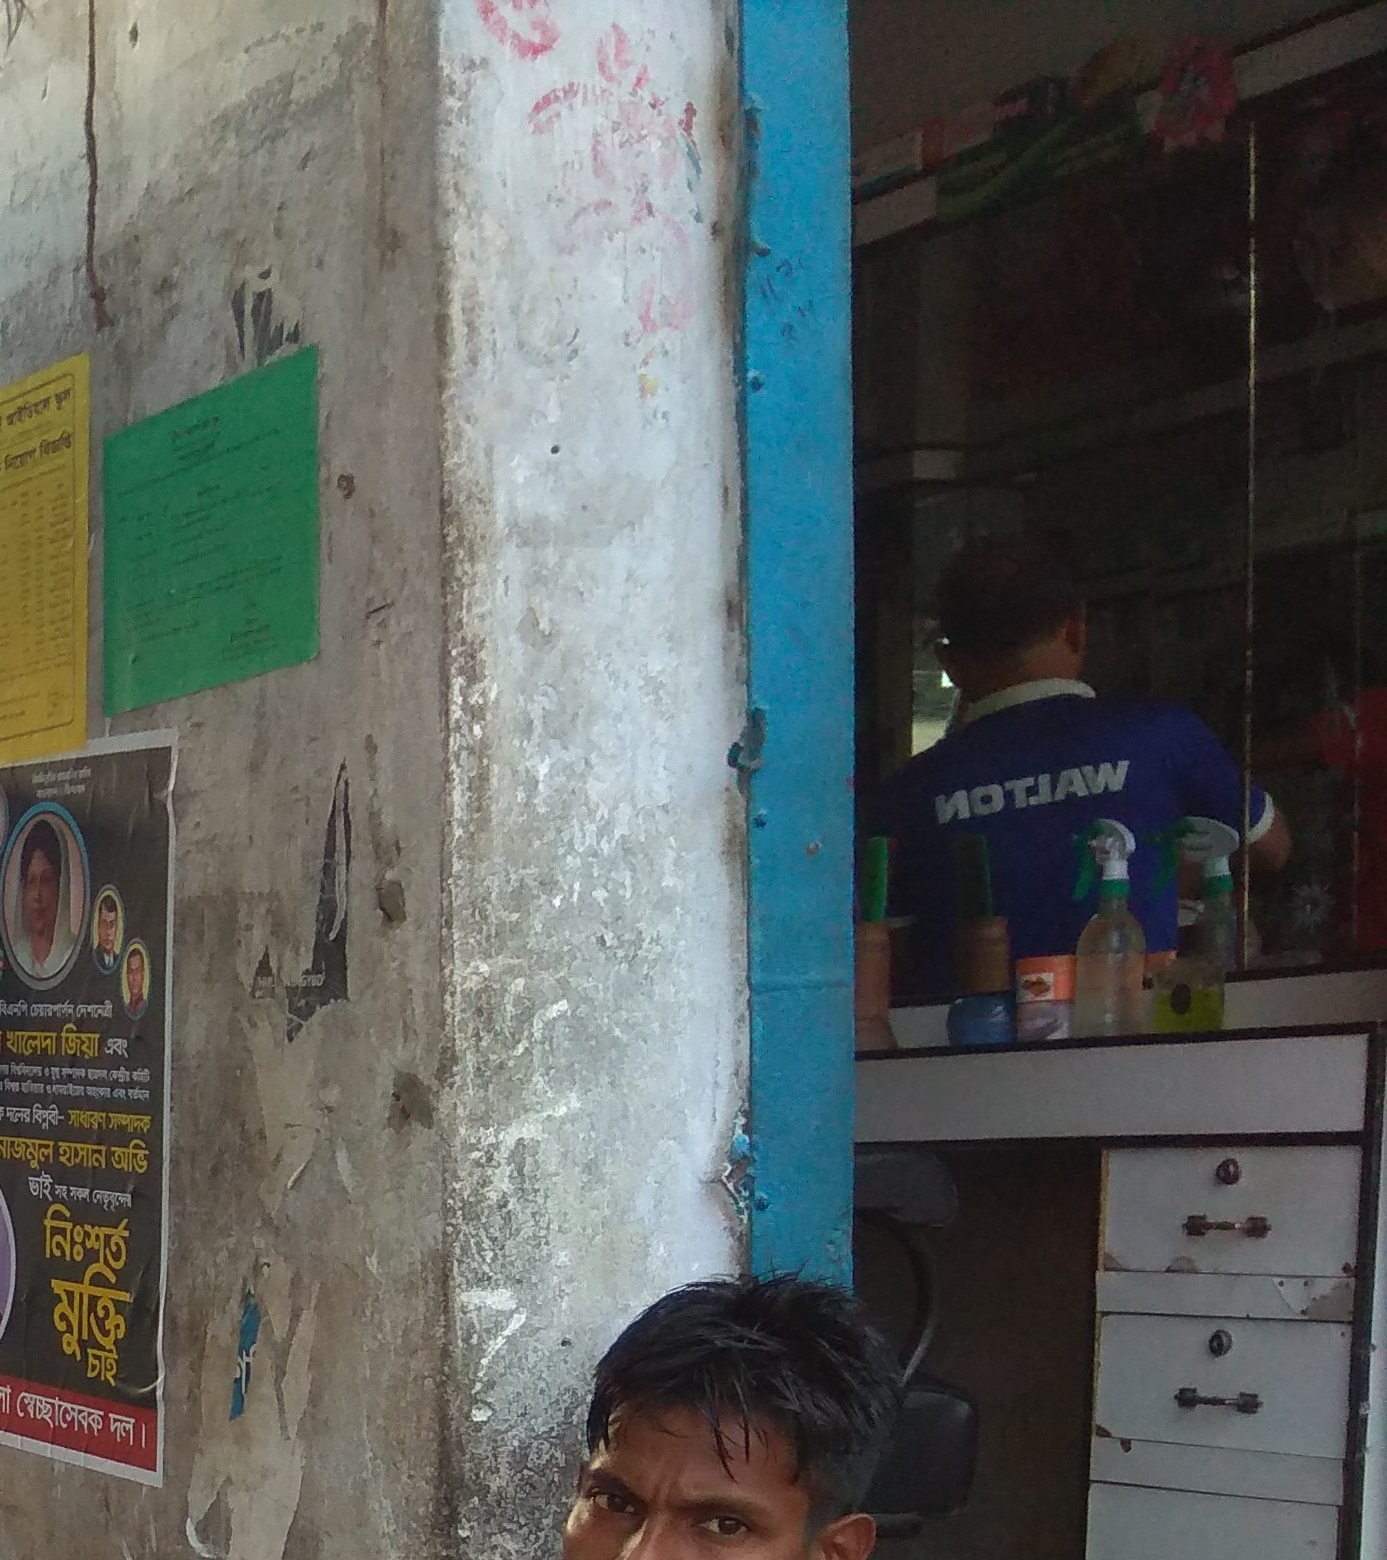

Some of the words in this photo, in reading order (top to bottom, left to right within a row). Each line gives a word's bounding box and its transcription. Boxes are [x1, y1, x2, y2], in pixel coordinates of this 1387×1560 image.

[6, 1030, 57, 1055] খালেদা
[61, 1023, 100, 1059] জিয়া
[105, 1037, 128, 1058] এবং
[6, 1106, 31, 1123] দলের
[108, 1112, 152, 1134] সম্পাদক
[58, 1141, 106, 1169] হাসান
[110, 1138, 150, 1174] অভি
[28, 1170, 53, 1201] ভাই
[43, 1202, 130, 1270] নিঃশর্ত
[51, 1263, 133, 1362] মুক্তি
[86, 1347, 119, 1387] চাই
[16, 1390, 104, 1437] স্বেচ্ছাসেবক
